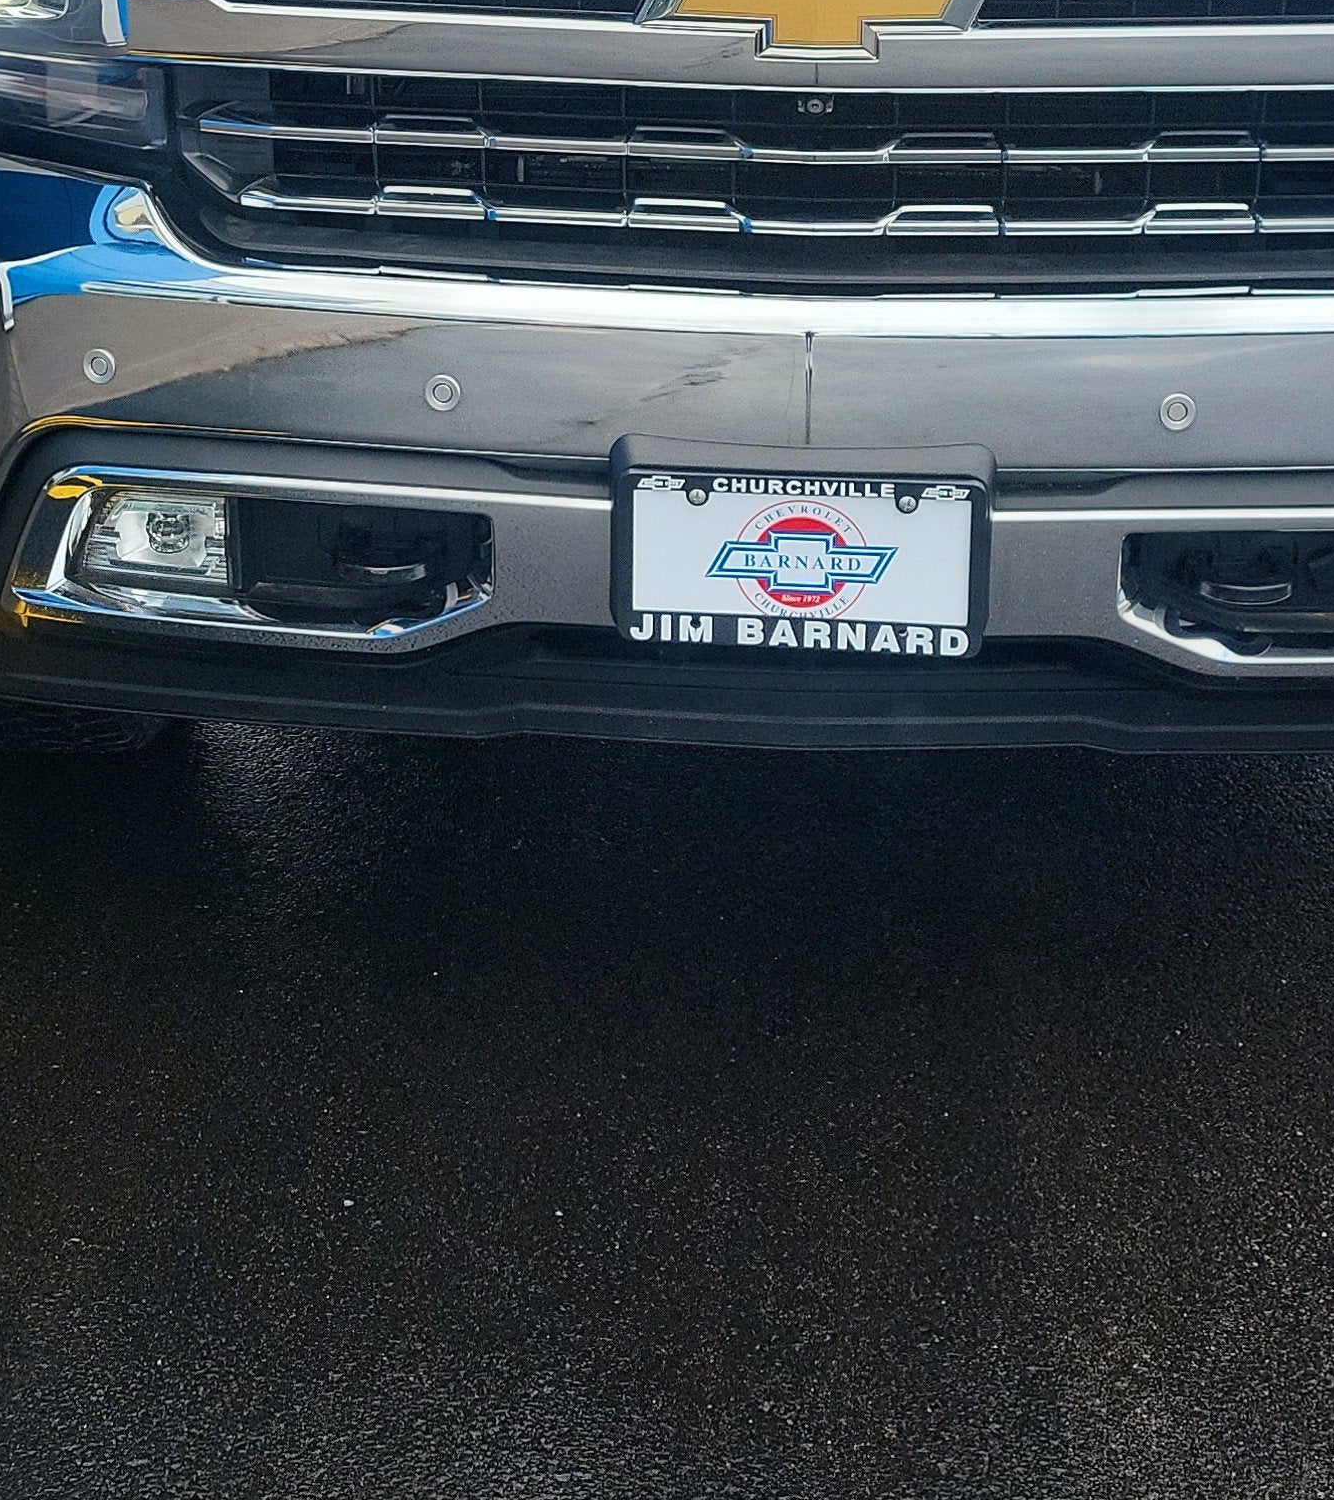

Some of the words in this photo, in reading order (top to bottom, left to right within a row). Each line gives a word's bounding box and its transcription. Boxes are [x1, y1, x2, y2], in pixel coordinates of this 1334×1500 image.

[711, 477, 896, 499] CHURCHVILLE
[754, 505, 853, 534] CHEVROLET
[744, 553, 862, 572] BARNARD
[781, 594, 802, 603] Since
[629, 613, 714, 643] JIM
[737, 618, 970, 657] BARNARD
